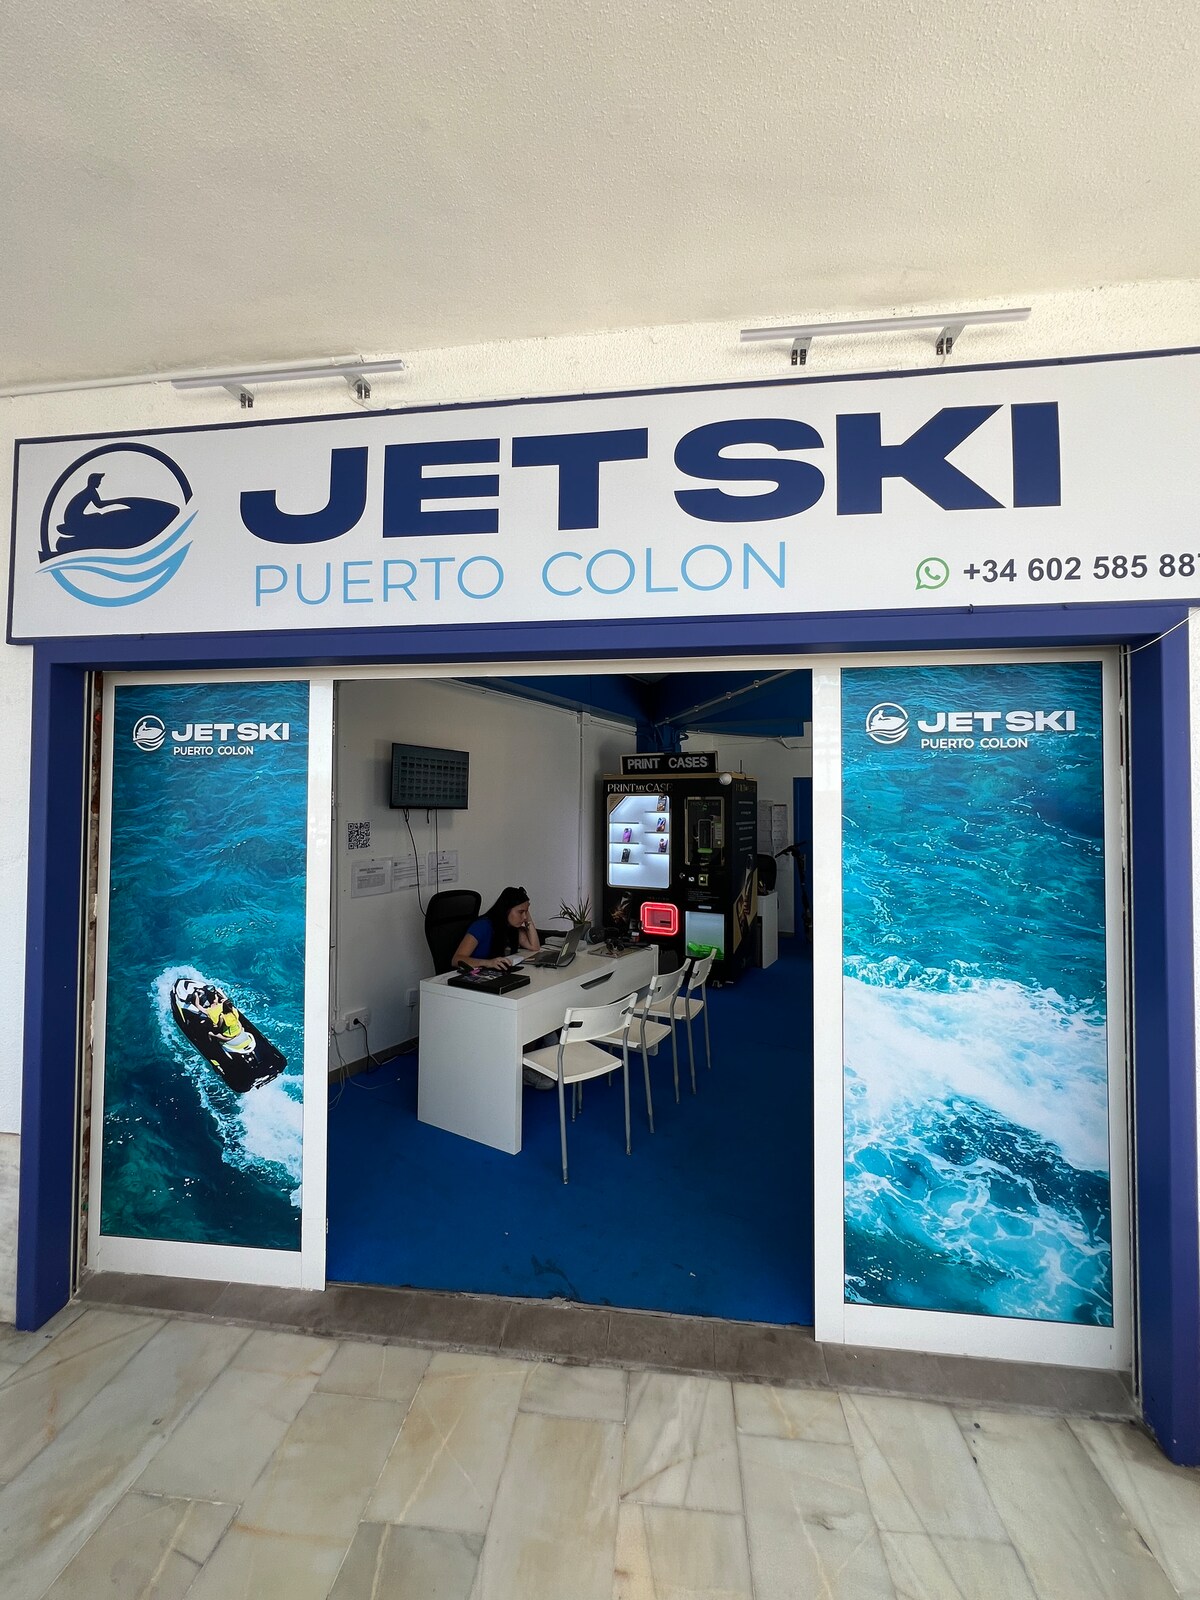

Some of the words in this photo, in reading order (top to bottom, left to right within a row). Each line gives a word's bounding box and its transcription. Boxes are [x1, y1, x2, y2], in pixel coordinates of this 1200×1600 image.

[240, 427, 648, 545] JET
[674, 401, 1062, 523] SKI
[254, 555, 505, 607] PUERTO
[541, 541, 787, 597] COLON
[963, 559, 1017, 583] +34
[1027, 556, 1081, 581] 602
[1093, 554, 1148, 579] 585
[1158, 552, 1200, 577] 88
[171, 723, 235, 742] JET
[236, 722, 290, 741] SKI
[917, 711, 1001, 733] JET
[1005, 710, 1076, 731] SKI
[173, 746, 214, 756] PUERTO
[217, 745, 254, 755] COLON
[921, 738, 975, 749] PUERTO
[979, 737, 1028, 748] COLON
[627, 758, 660, 769] PRINT
[668, 756, 709, 768] CASES
